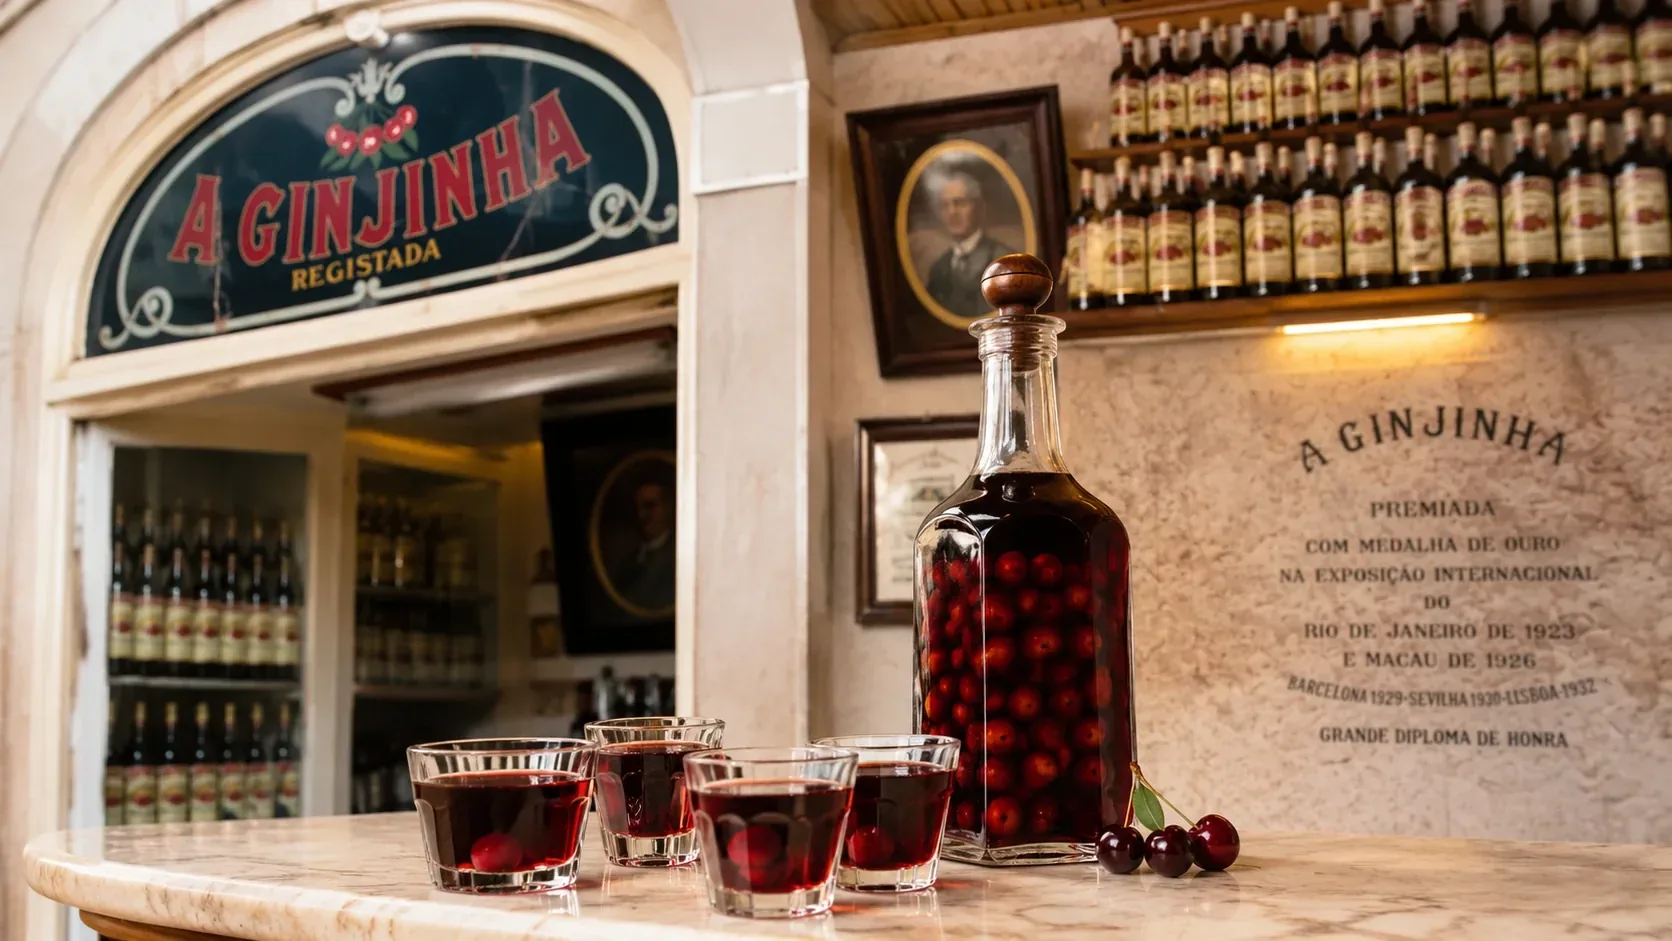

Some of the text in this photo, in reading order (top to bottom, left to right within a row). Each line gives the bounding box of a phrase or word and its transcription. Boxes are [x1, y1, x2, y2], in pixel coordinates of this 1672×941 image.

[168, 88, 592, 267] A GINJINHA
[291, 239, 442, 292] REGISTADA
[1300, 405, 1567, 473] A GINJINHA
[1370, 501, 1497, 518] PREMIADA
[1306, 536, 1561, 554] COM MEDALHA DE OURO
[1279, 564, 1600, 585] NA EXPOSIÇÃO INTERNACIONAL
[1424, 595, 1450, 609] DO
[1304, 623, 1575, 640] RIO DE JANEIRO DE 1923
[1343, 652, 1537, 669] E MACAU DE 1926
[1287, 675, 1367, 703] BARCELONA
[1319, 727, 1568, 748] GRANDE DIPLOMA DE HONRA
